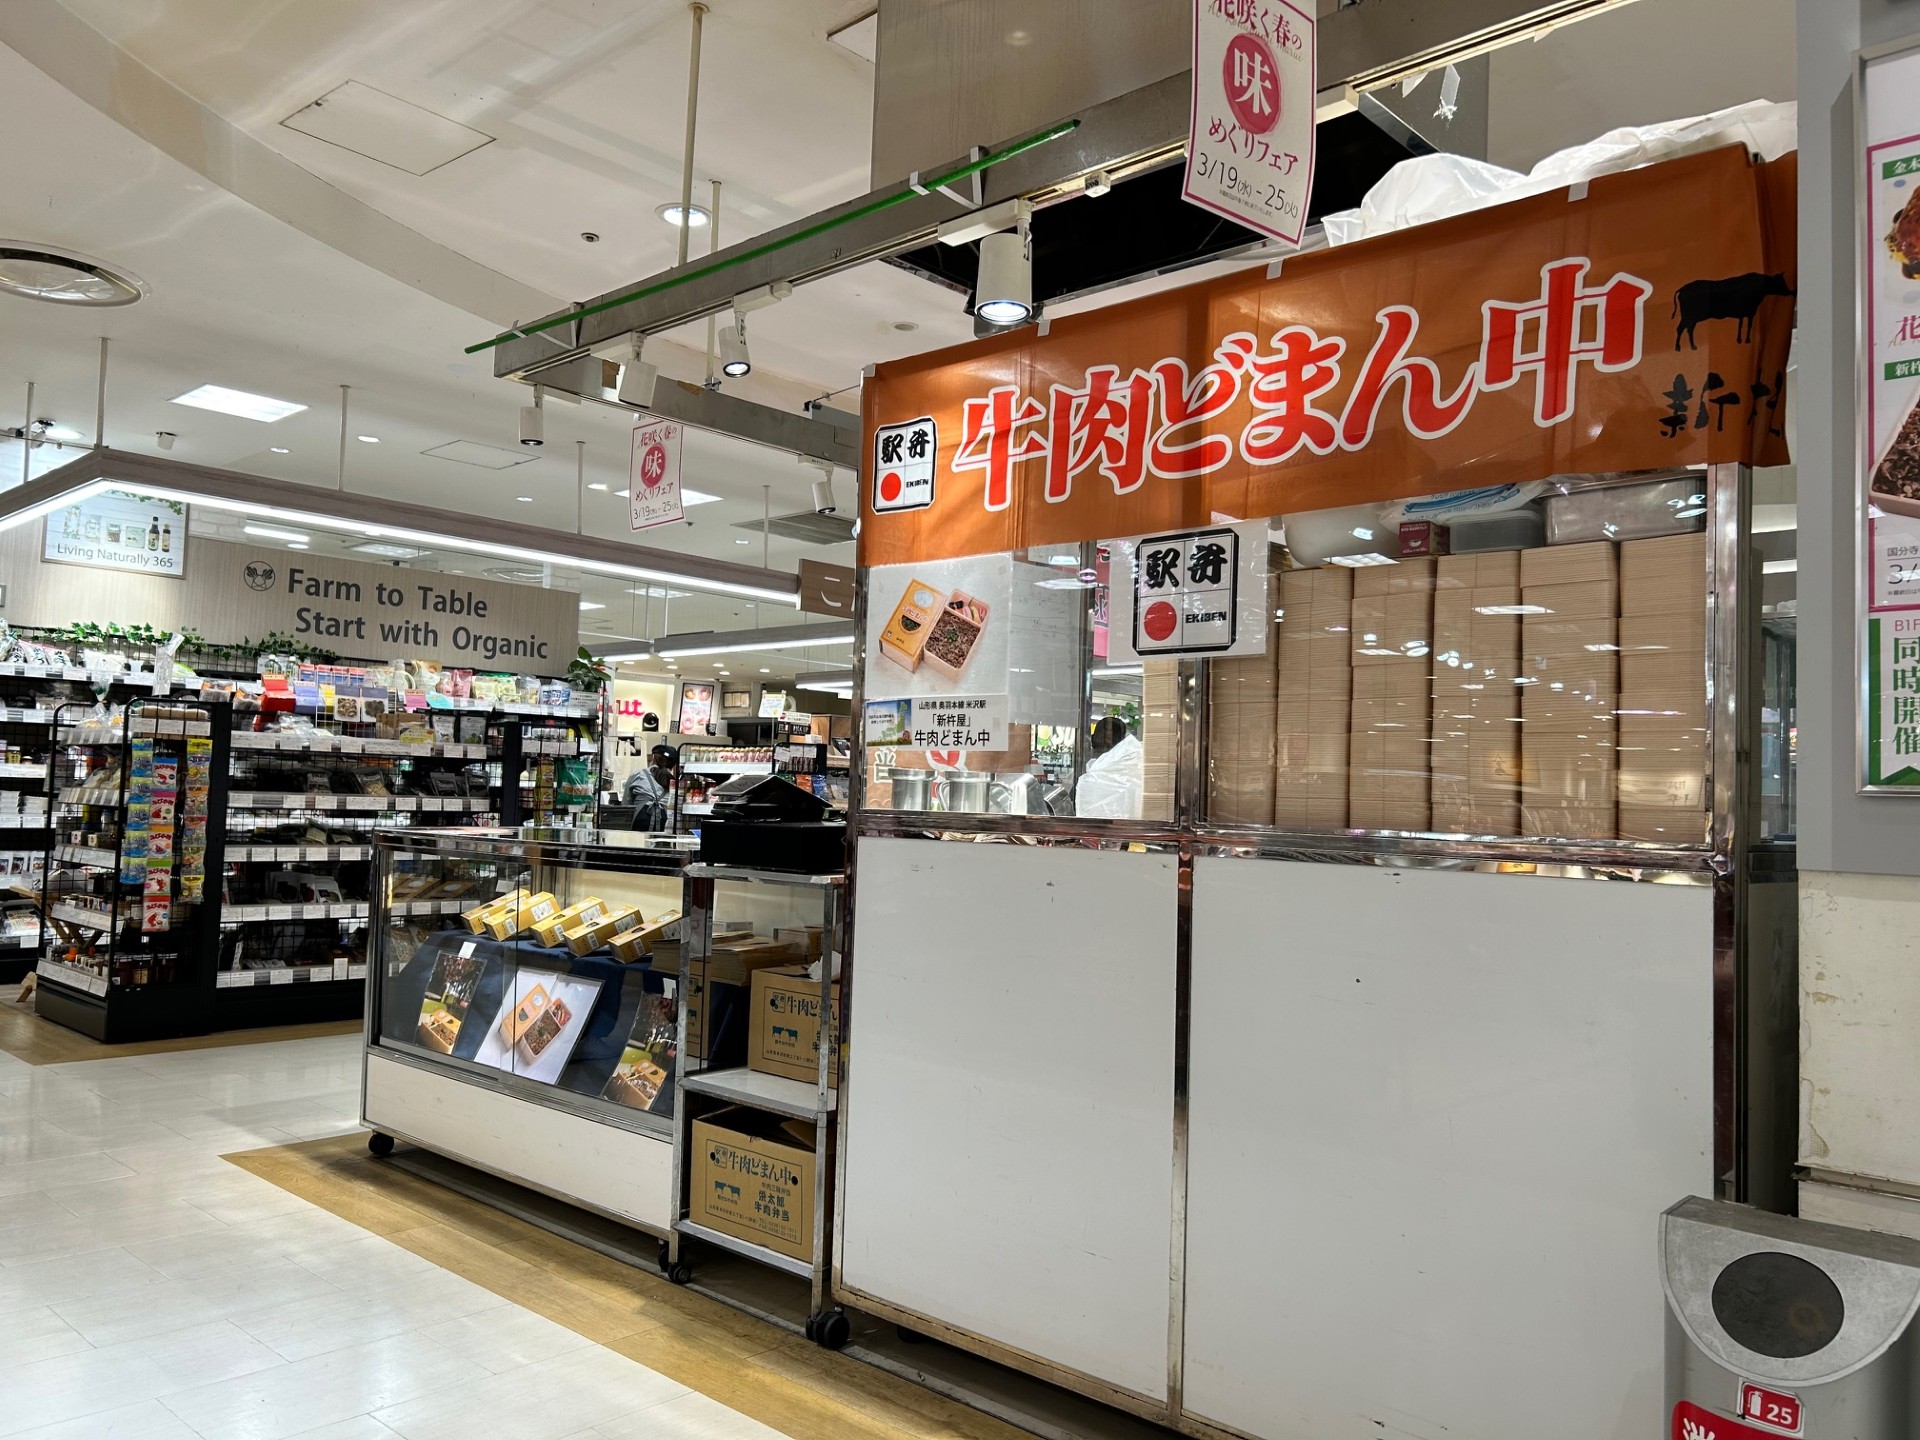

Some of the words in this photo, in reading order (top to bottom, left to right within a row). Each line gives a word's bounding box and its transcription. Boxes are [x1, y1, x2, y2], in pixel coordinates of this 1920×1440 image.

[1233, 47, 1272, 117] 味
[1208, 115, 1299, 177] めぐりフェア
[952, 256, 1653, 512] 牛肉どまん中
[880, 427, 931, 464] 駅弁
[645, 450, 662, 479] 味
[906, 478, 930, 489] EKIBEN
[57, 543, 94, 560] Living
[97, 548, 150, 567] Naturally
[152, 555, 174, 569] 365
[1887, 545, 1919, 557] 国分寺
[1144, 542, 1229, 590] 駅弁
[287, 567, 361, 602] Farm
[376, 582, 404, 607] to
[418, 585, 488, 618] Table
[1185, 611, 1228, 624] EKIBEN
[295, 607, 366, 640] Start
[380, 619, 439, 648] with
[452, 625, 549, 660] Organic
[918, 701, 938, 711] 山形県
[938, 700, 965, 710] 奥羽本線
[965, 699, 987, 709] 米沢駅
[914, 729, 990, 747] 牛肉どまん中
[728, 1150, 792, 1185] 牛肉どまん中
[754, 1201, 790, 1222] 牛肉弁当
[1766, 1403, 1793, 1425] 25
